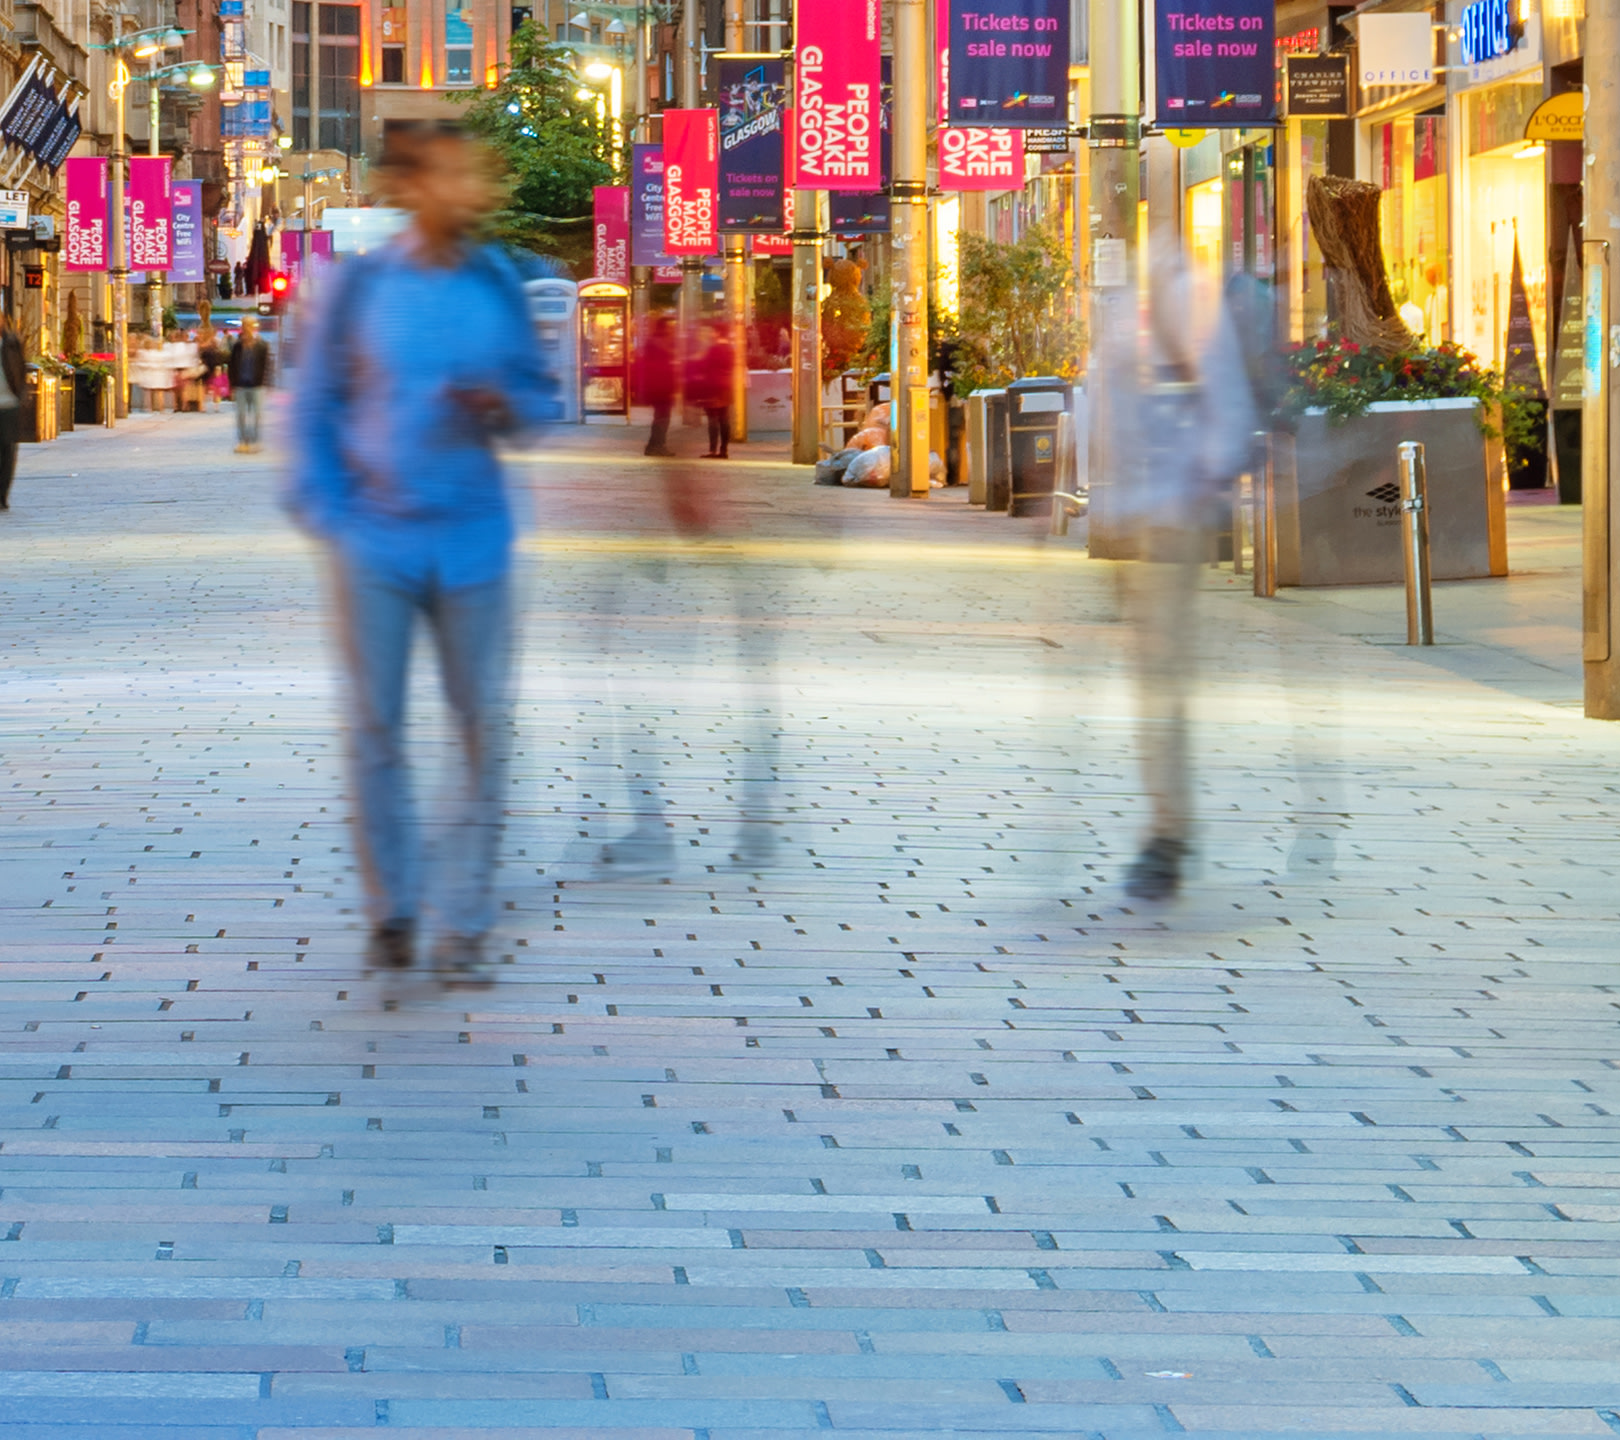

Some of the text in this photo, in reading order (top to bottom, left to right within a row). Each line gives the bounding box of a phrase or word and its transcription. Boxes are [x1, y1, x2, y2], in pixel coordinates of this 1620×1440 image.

[962, 14, 1058, 31] Tickets on
[1167, 13, 1263, 31] Tickets on
[967, 39, 1052, 57] sale now
[1173, 40, 1257, 57] sale now
[1365, 70, 1430, 81] OFFICE
[800, 45, 823, 176] GLASGOW
[1535, 114, 1583, 126] L'OCCI
[723, 109, 777, 150] GLASGOW
[823, 104, 845, 176] MAKE
[847, 83, 869, 176] PEOPLE
[967, 128, 989, 176] AKE
[645, 183, 663, 193] City
[726, 173, 778, 183] Tickets on
[729, 188, 775, 197] sale now
[6, 192, 27, 201] LET
[641, 193, 664, 202] Centr
[667, 165, 682, 247] GLASGOW
[68, 200, 80, 265] GLASGOW
[132, 200, 145, 265] GLASGOW
[682, 201, 697, 246] MAKE
[696, 188, 712, 246] PEOPLE
[80, 228, 91, 264] MAKE
[91, 218, 103, 264] PEOPLE
[145, 228, 157, 264] MAKE
[155, 218, 168, 264] PEOPLE
[26, 273, 42, 286] T2
[1376, 505, 1400, 518] styl
